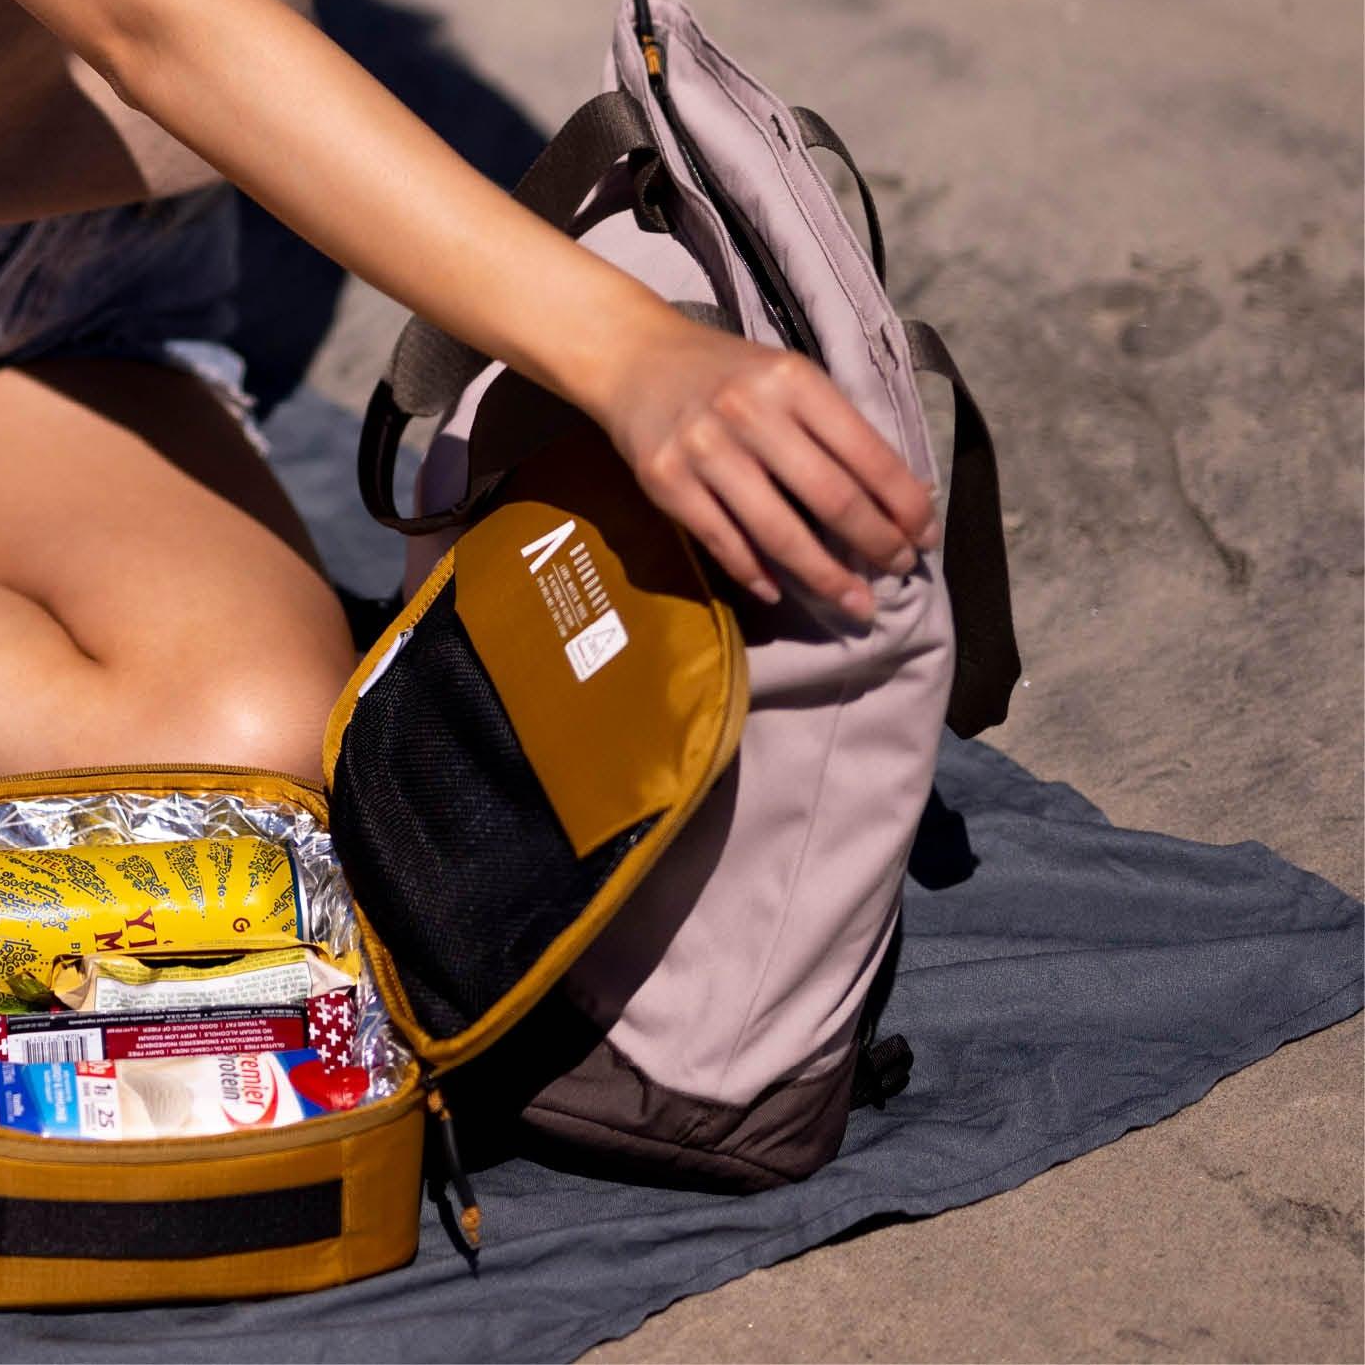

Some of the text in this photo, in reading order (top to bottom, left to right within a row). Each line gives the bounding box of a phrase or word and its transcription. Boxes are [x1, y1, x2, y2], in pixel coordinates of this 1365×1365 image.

[29, 855, 60, 871] LIFE
[179, 1038, 219, 1046] ENGINEERED
[220, 1036, 263, 1044] GENETICALLY
[136, 1041, 178, 1049] INGREDIENTS
[98, 1107, 114, 1128] 25
